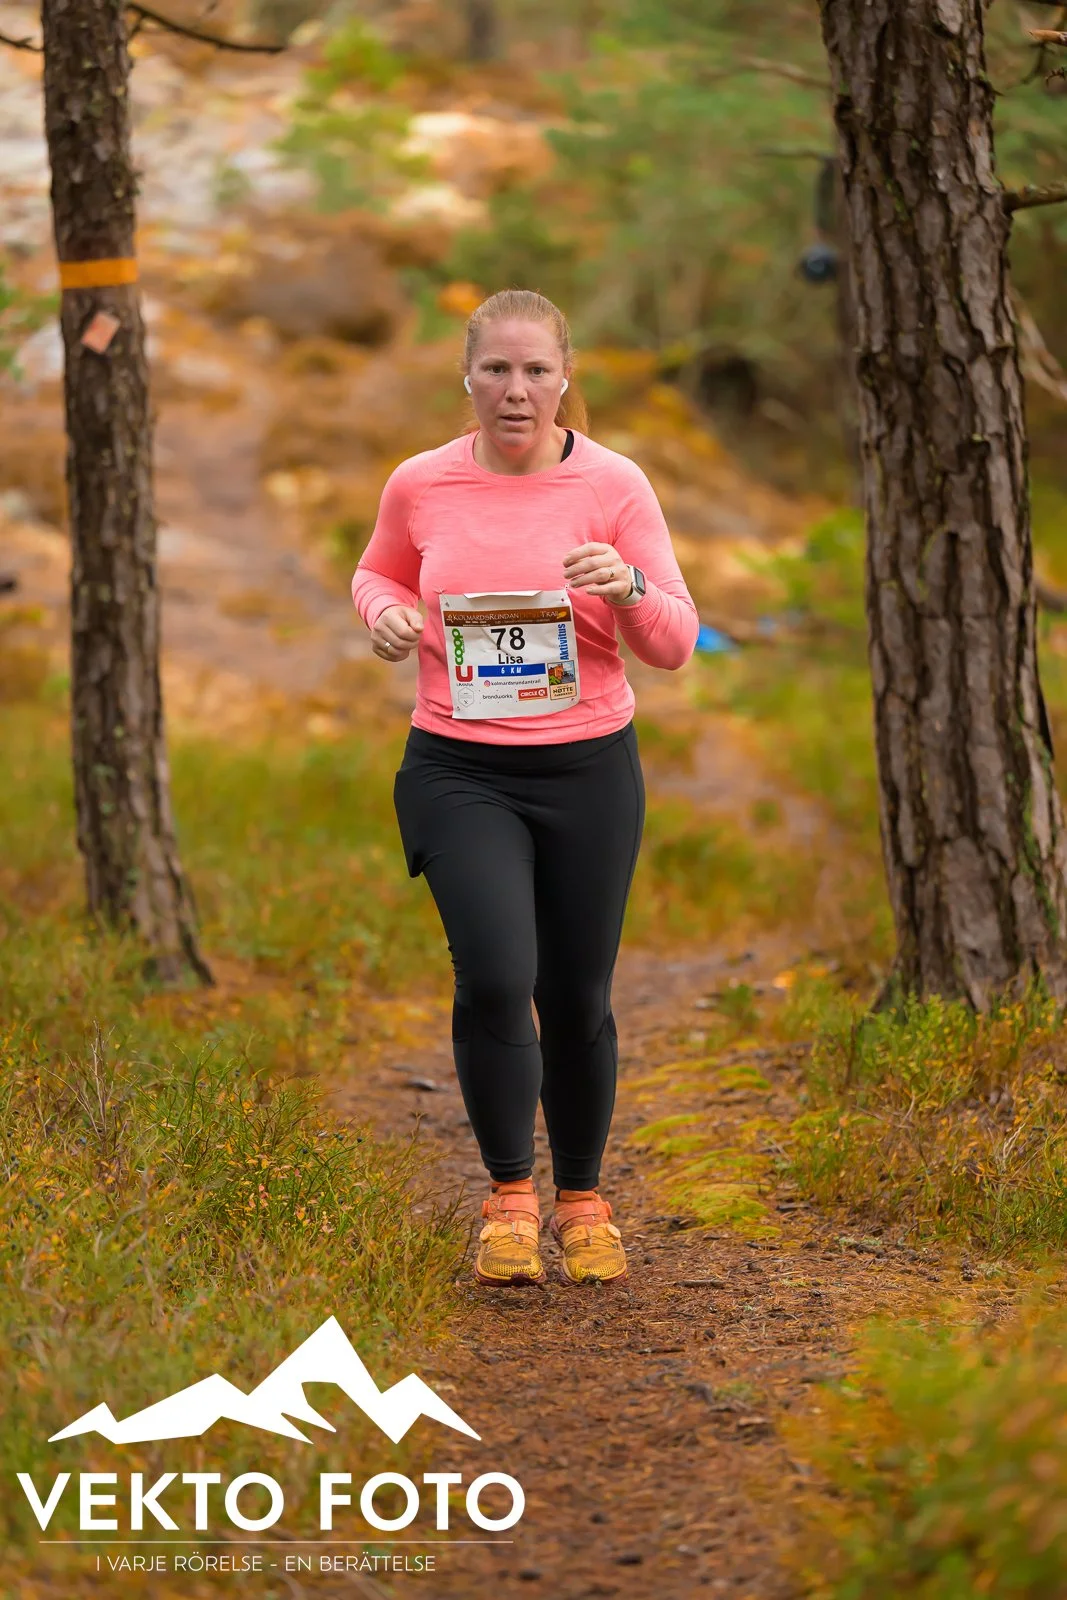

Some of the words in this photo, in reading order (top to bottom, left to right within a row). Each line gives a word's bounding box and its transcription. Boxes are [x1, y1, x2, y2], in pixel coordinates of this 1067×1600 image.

[490, 626, 526, 651] 78
[557, 623, 570, 661] Aktivitus
[498, 653, 524, 665] Lisa
[500, 666, 506, 675] 6
[510, 666, 522, 674] KM
